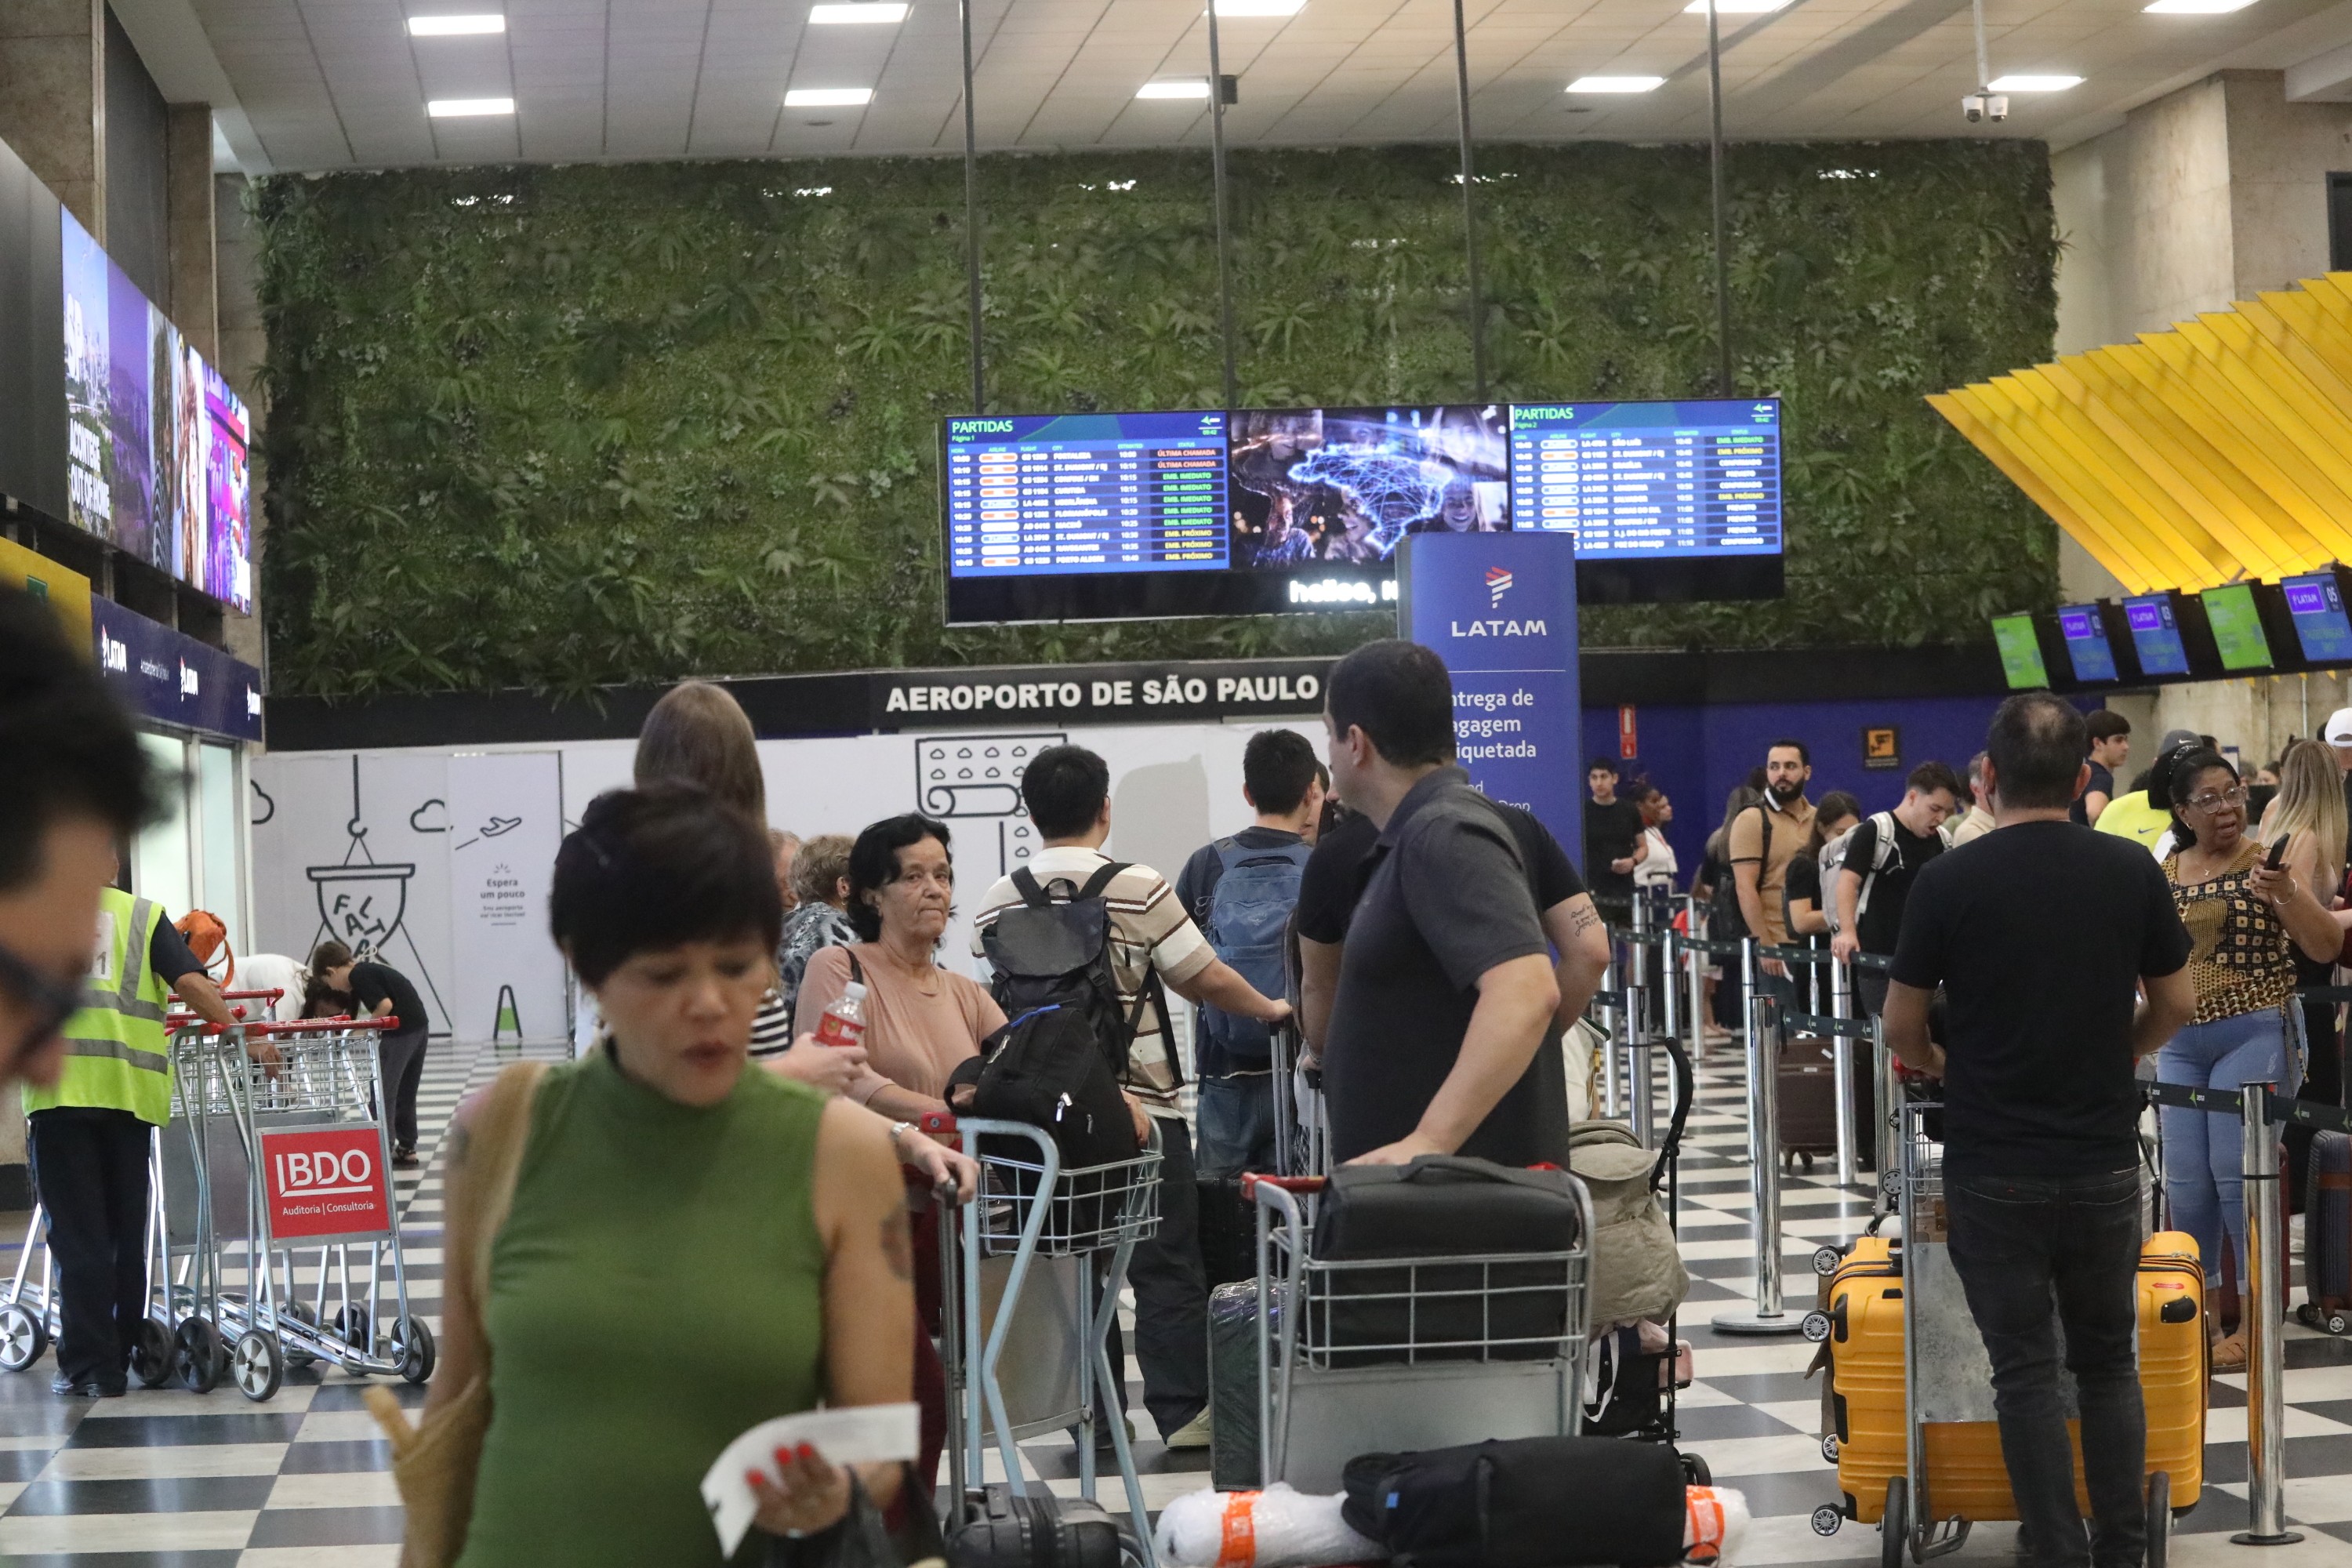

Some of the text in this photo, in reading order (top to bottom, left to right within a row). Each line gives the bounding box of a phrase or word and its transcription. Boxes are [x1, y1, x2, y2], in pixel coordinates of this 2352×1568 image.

[1515, 408, 1573, 420] PARTIDAS
[952, 420, 1013, 433] PARTIDAS
[2298, 594, 2318, 604] LATAM
[2327, 586, 2338, 602] 05
[1451, 620, 1548, 637] LATAM
[886, 675, 1319, 713] AEROPORTO DE SÃO PAULO
[1452, 688, 1534, 711] ntrega de
[1457, 740, 1536, 764] iquetada
[487, 879, 517, 888] Espera
[282, 1201, 374, 1216] Auditoria Consultoria
